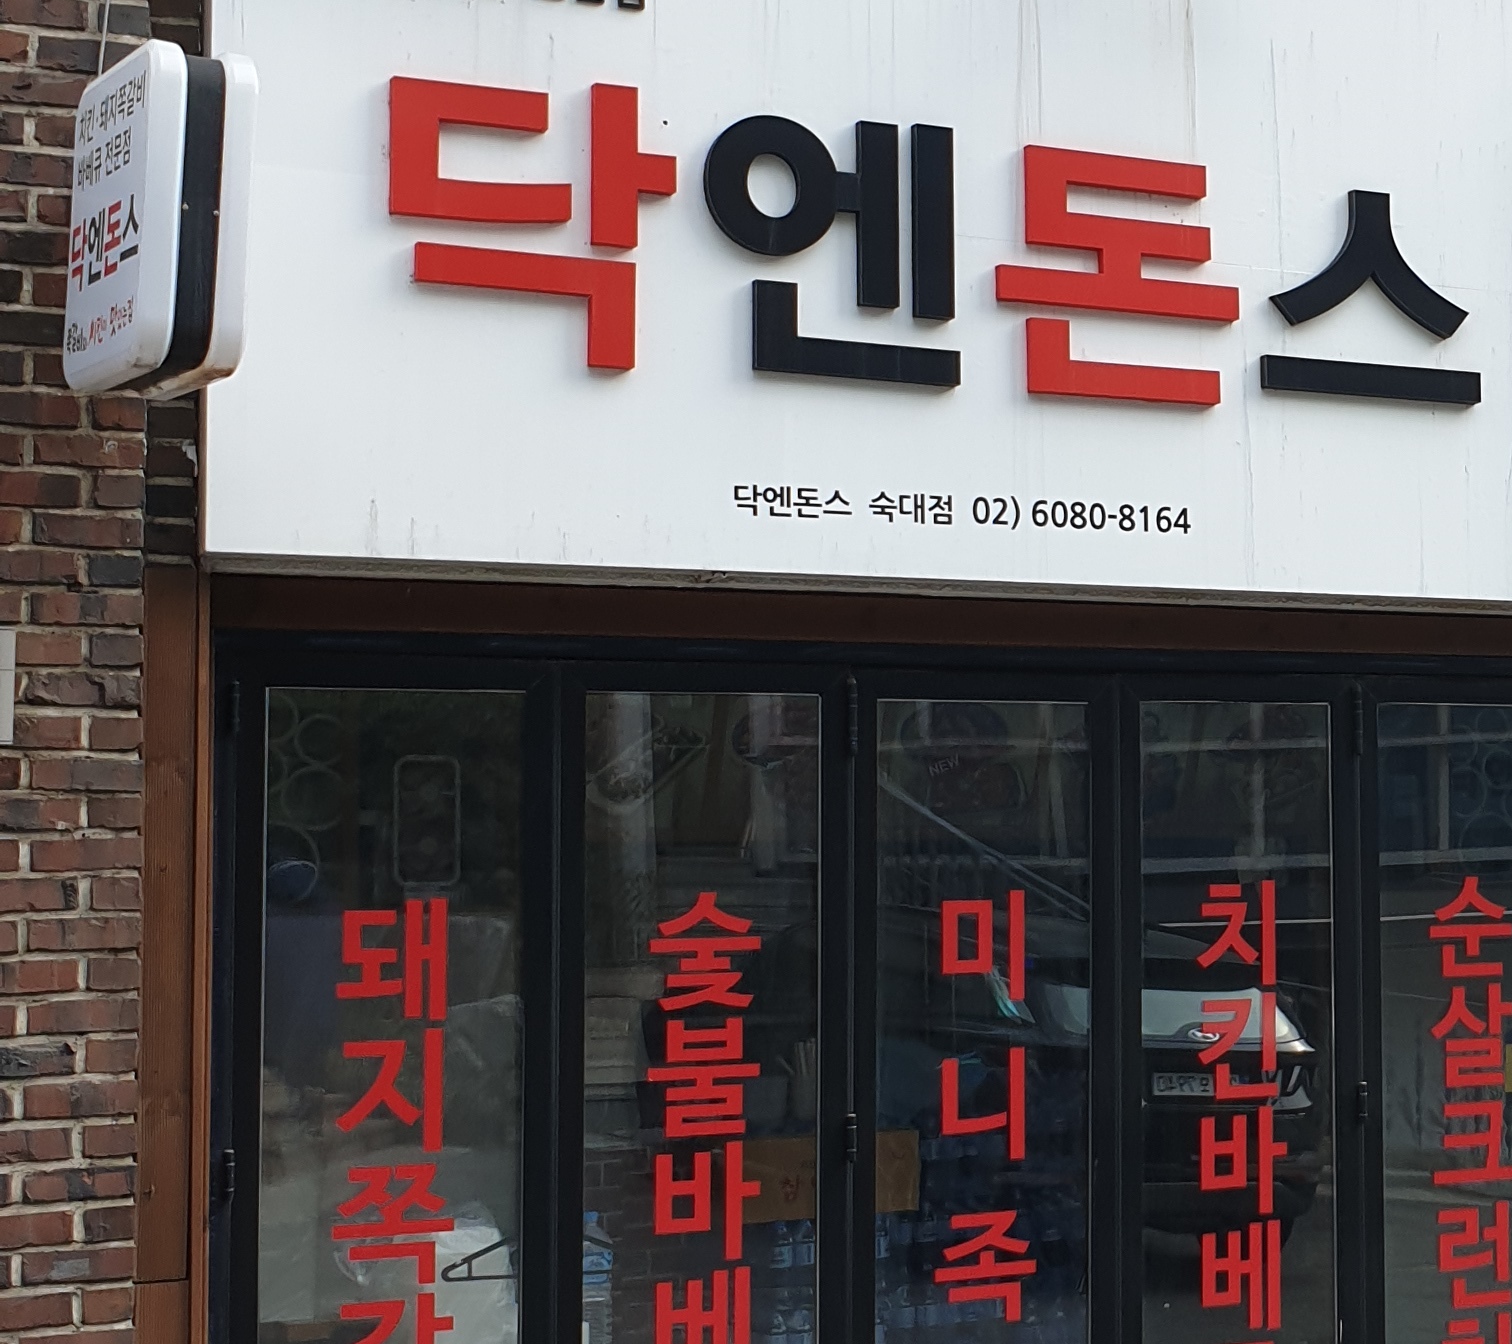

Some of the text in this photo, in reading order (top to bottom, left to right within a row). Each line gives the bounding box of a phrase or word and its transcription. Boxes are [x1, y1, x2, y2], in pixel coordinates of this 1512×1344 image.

[77, 126, 132, 192] 바베큐 전문점
[71, 194, 139, 292] 닥엔돈스
[389, 77, 1481, 411] 닥엔돈스
[733, 484, 1192, 535] 닥엔돈스 숙대점 02) 6080-8164
